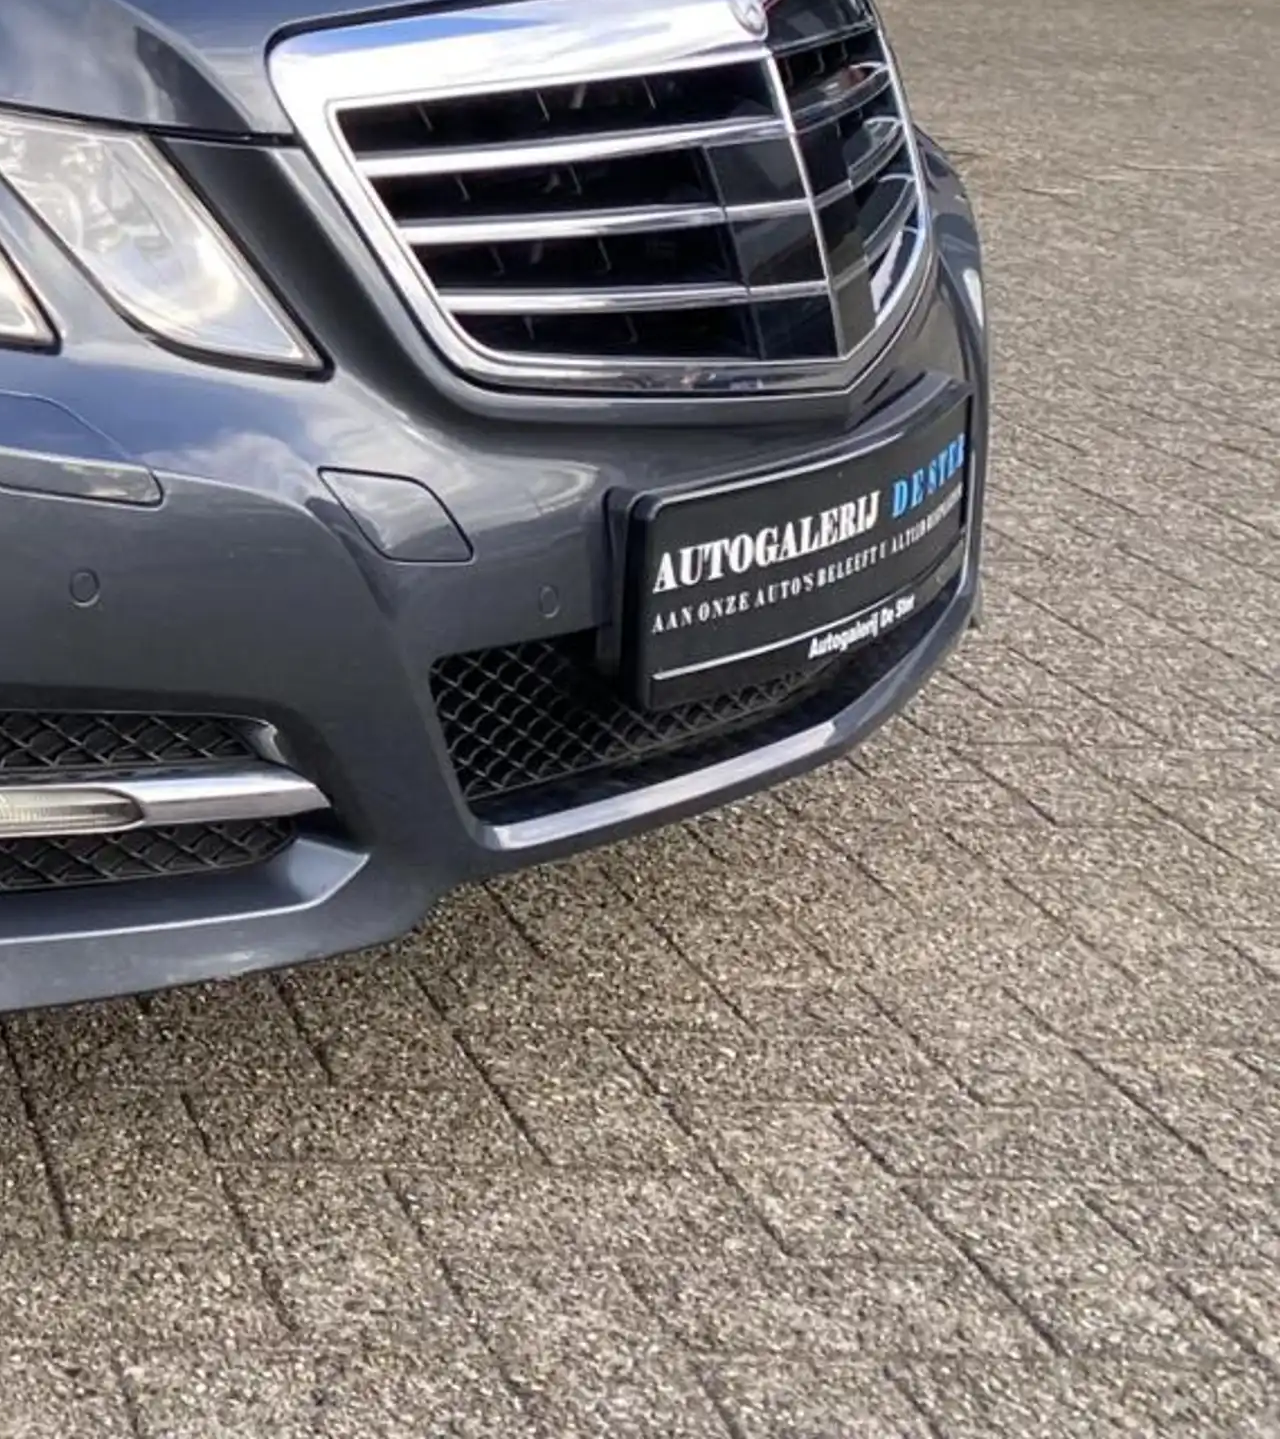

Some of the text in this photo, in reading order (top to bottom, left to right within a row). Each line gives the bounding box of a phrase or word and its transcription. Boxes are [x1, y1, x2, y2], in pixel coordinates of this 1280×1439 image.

[651, 490, 881, 594] AUTOGALERIJ
[891, 469, 924, 518] DE
[650, 603, 693, 635] AAN
[697, 590, 750, 621] ONZE
[816, 546, 877, 584] BELEEFT
[807, 613, 879, 659] Autogalerij
[879, 606, 895, 629] De
